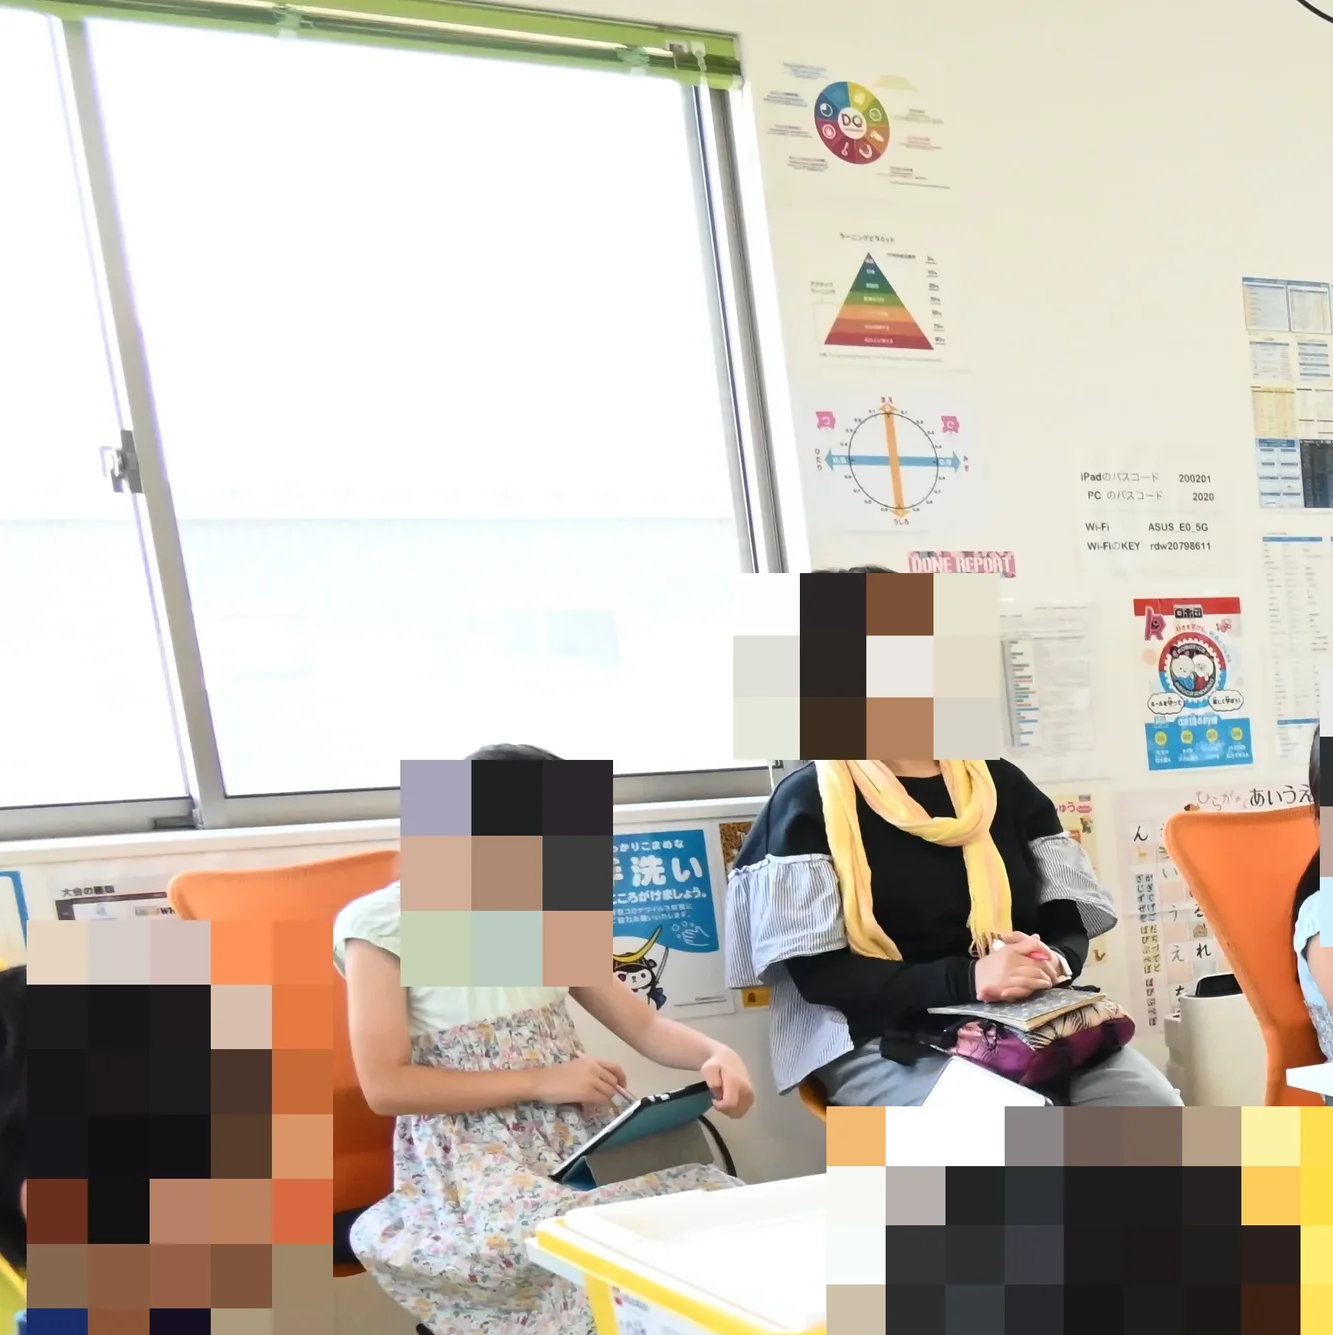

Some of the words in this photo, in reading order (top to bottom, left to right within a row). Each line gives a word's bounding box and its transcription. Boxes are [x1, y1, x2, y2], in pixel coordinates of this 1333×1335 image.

[1178, 474, 1211, 483] 200201
[1087, 491, 1102, 500] PC
[1192, 492, 1214, 501] 2020
[1085, 522, 1109, 532] Wi-Fi
[911, 552, 953, 573] DONE
[955, 551, 1013, 573] REPORT
[1133, 825, 1149, 842] ん
[1196, 942, 1211, 959] れ
